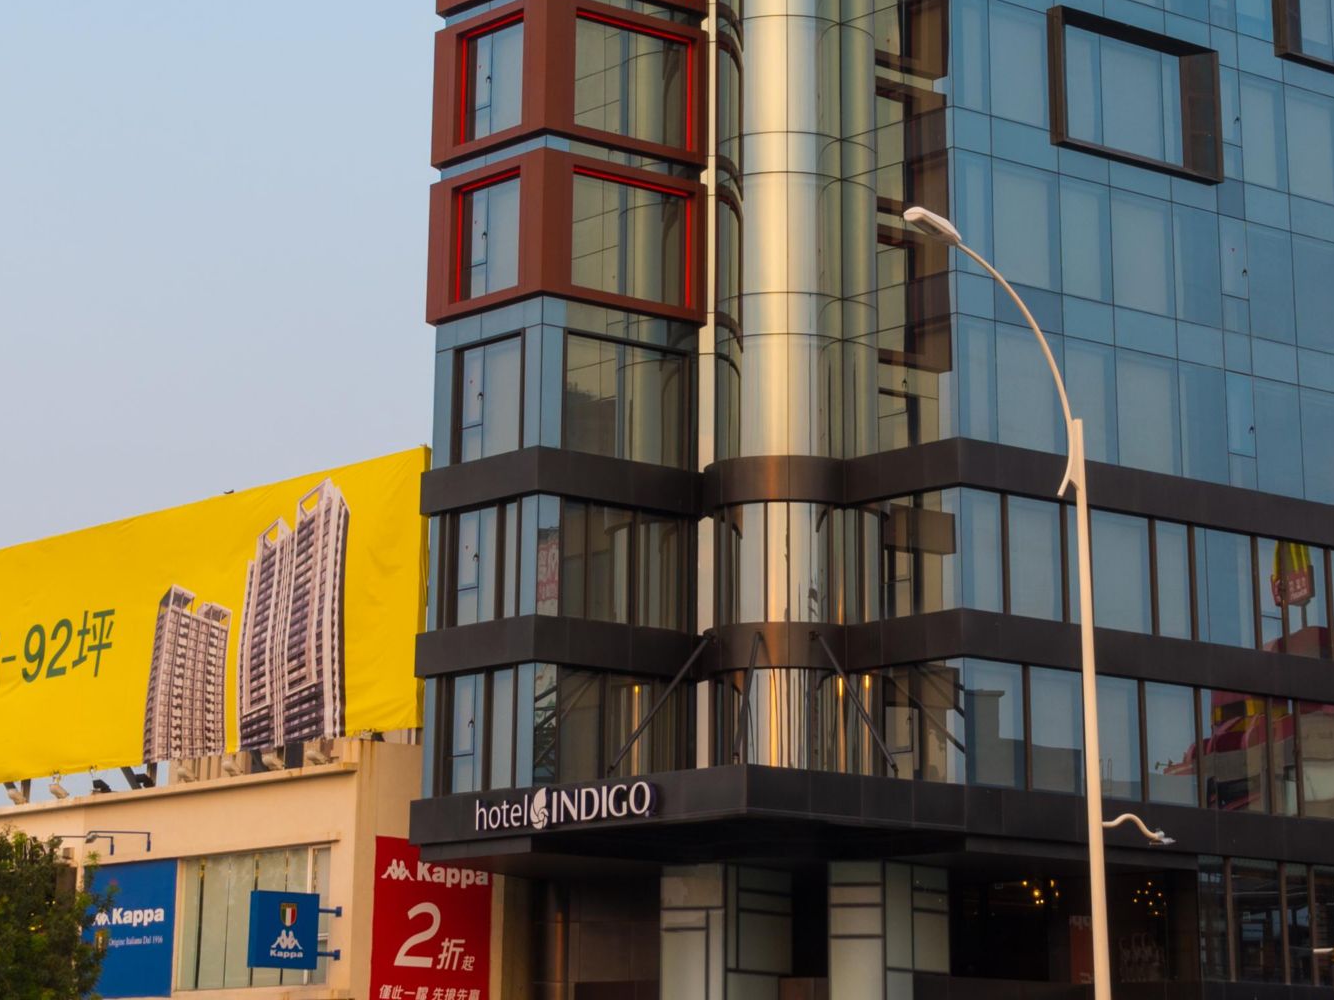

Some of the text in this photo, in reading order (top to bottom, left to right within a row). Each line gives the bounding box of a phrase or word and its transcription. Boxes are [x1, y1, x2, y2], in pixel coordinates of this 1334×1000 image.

[475, 781, 651, 831] hotel INDIGO
[417, 861, 489, 889] Kappa
[112, 907, 165, 927] Kappa
[269, 949, 304, 959] Kappa
